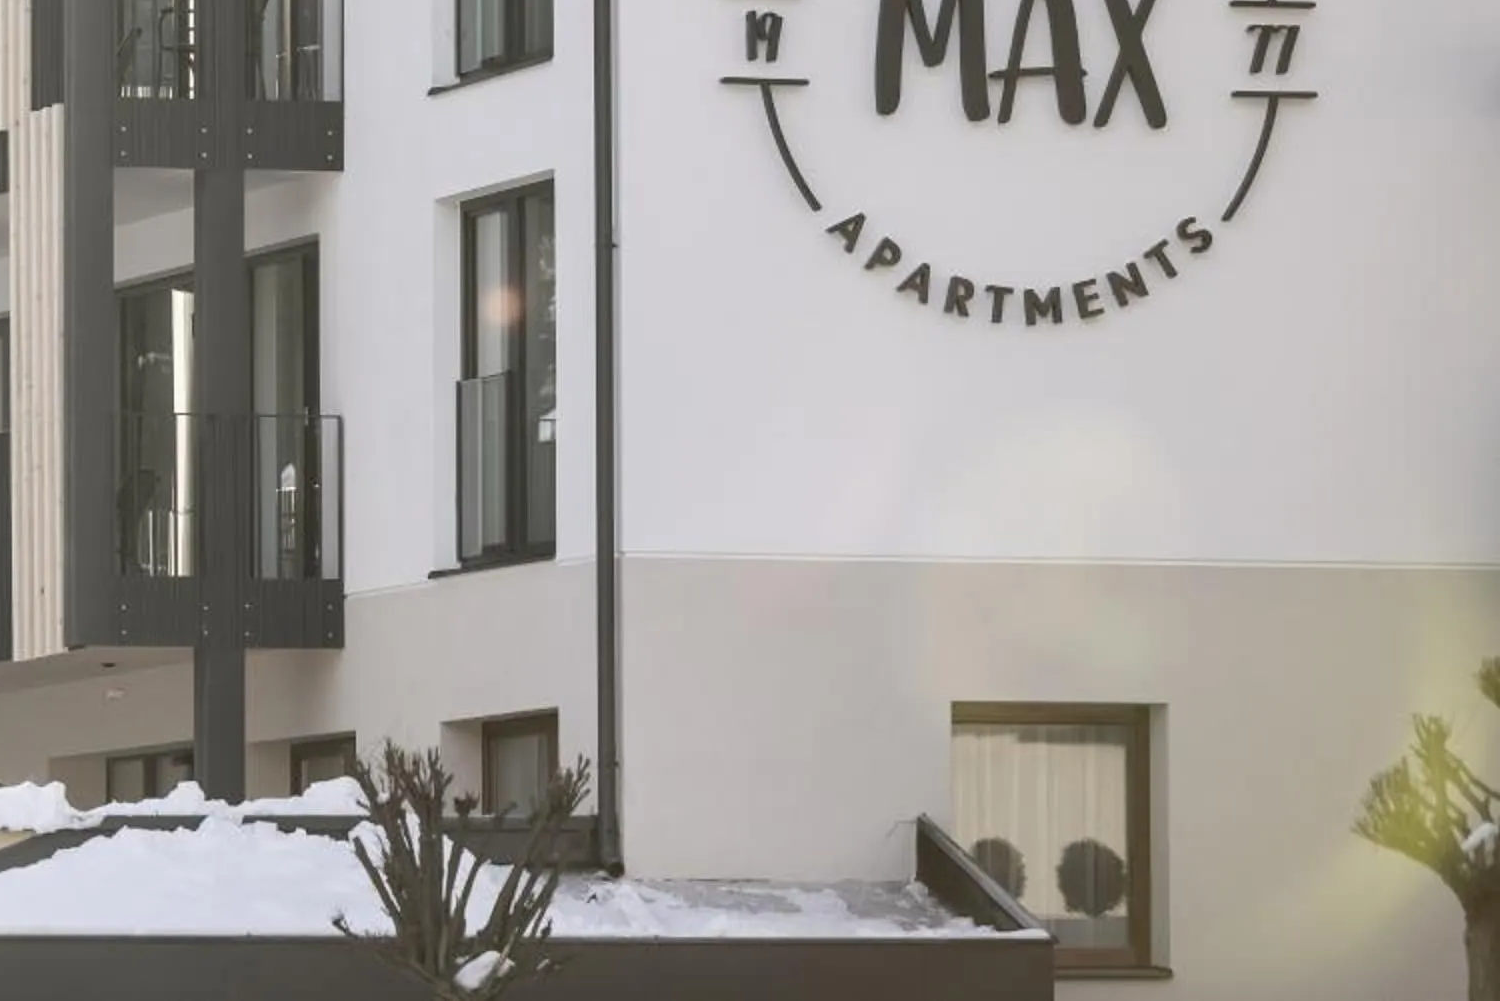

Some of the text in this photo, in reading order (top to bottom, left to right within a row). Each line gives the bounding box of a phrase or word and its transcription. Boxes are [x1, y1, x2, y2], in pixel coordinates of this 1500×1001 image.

[745, 10, 784, 64] 19
[1245, 24, 1301, 76] 77
[825, 212, 1213, 327] APARTMENTS
